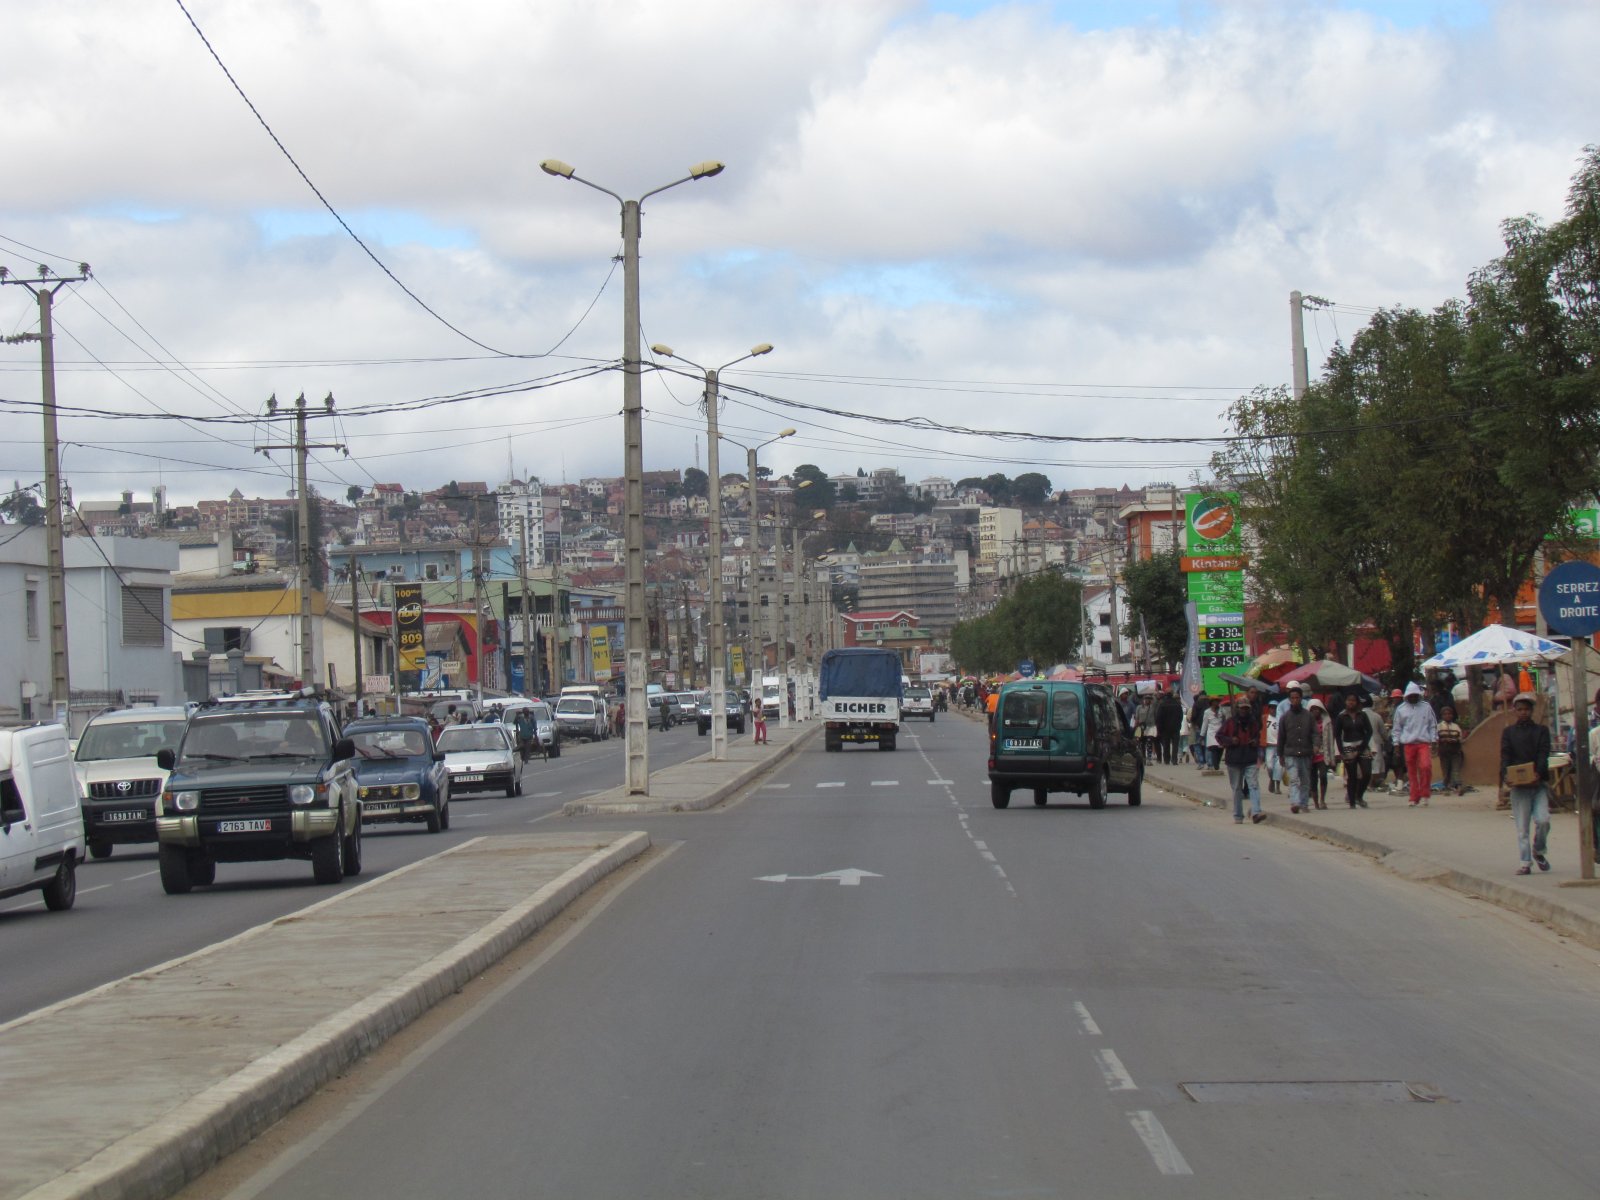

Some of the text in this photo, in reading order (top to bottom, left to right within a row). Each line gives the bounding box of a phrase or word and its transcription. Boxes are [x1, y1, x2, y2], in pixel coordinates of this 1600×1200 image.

[1556, 582, 1599, 593] SERREZ
[1574, 595, 1581, 604] A
[1560, 606, 1599, 618] DROITE
[401, 633, 423, 644] 809
[834, 702, 887, 714] EICHER
[223, 820, 265, 832] 2763 TAV
